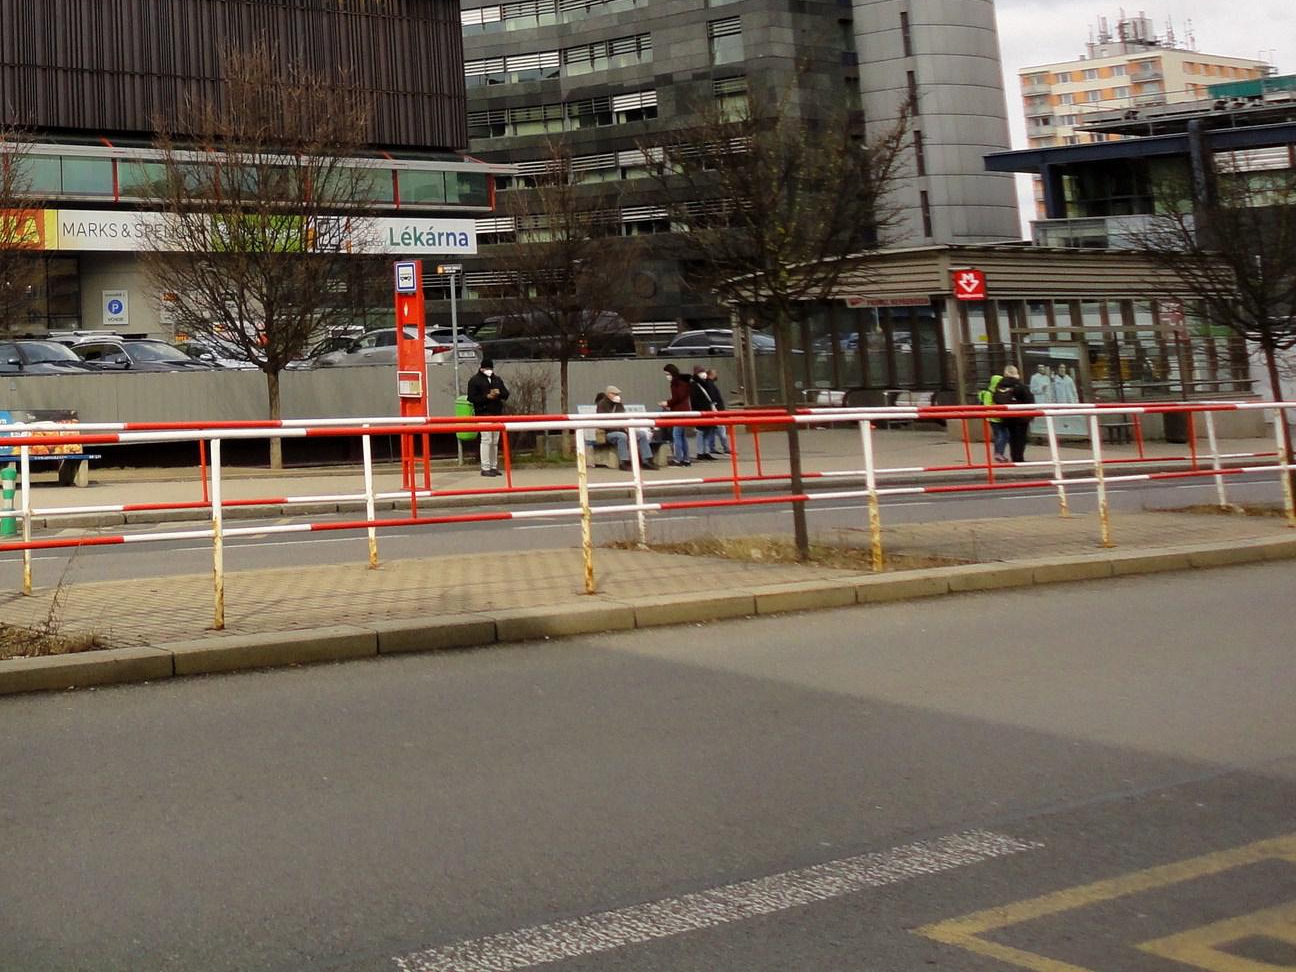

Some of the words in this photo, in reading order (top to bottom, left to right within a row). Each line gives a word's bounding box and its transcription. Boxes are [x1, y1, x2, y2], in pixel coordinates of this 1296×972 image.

[62, 222, 118, 238] MARKS
[121, 223, 131, 239] &
[389, 226, 469, 247] Lékárna
[111, 303, 120, 313] P
